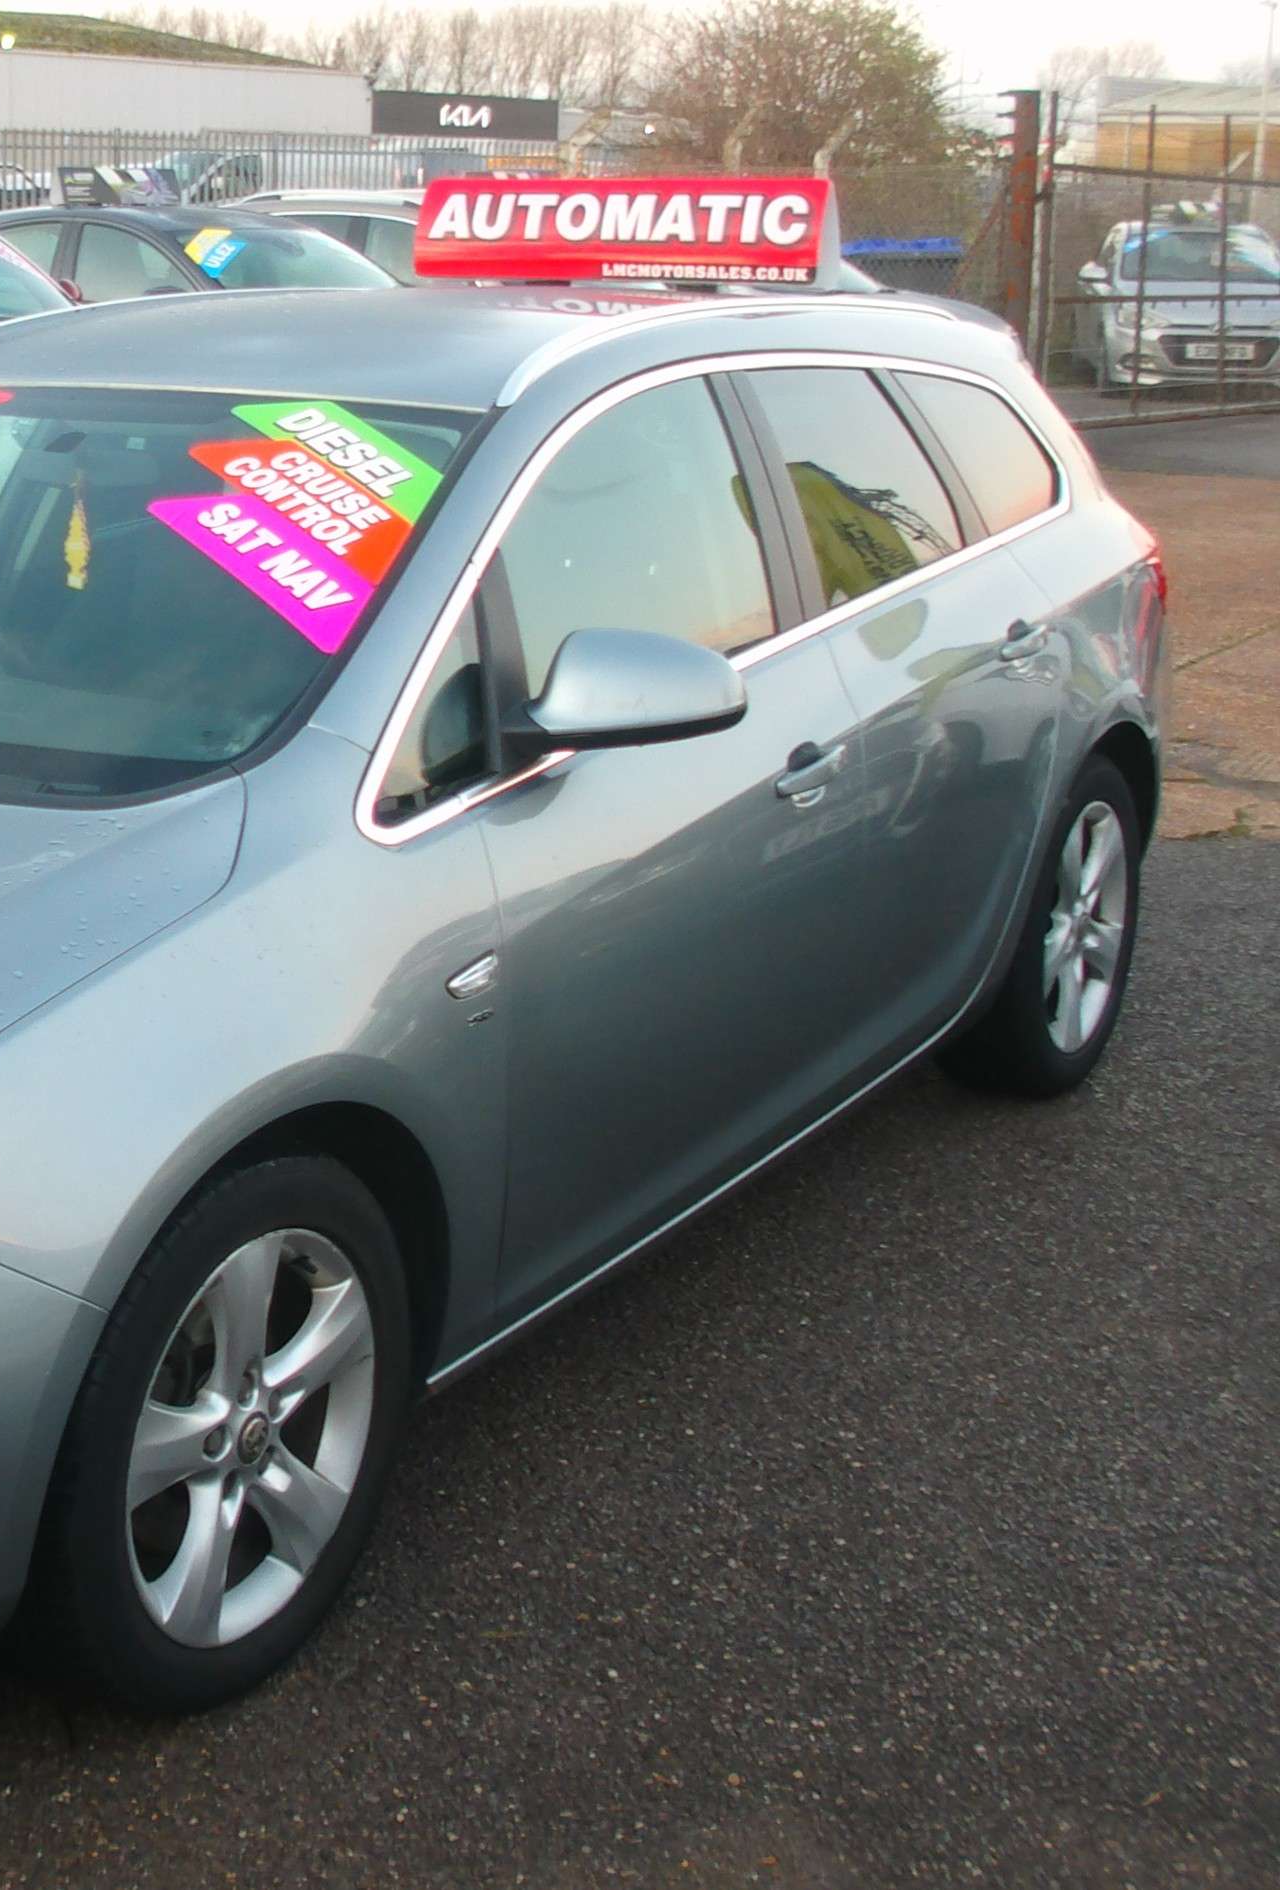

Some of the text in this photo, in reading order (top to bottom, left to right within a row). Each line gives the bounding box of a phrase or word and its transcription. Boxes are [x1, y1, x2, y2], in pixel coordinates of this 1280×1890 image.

[439, 103, 493, 129] KIA
[427, 193, 811, 246] AUTOMATIC
[602, 263, 809, 282] LMCMOTORSALES.CO.UK
[269, 450, 391, 531] CRUISE
[274, 407, 414, 499] DIESEL
[223, 456, 363, 556] CONTROL
[196, 502, 354, 611] SAT NAV
